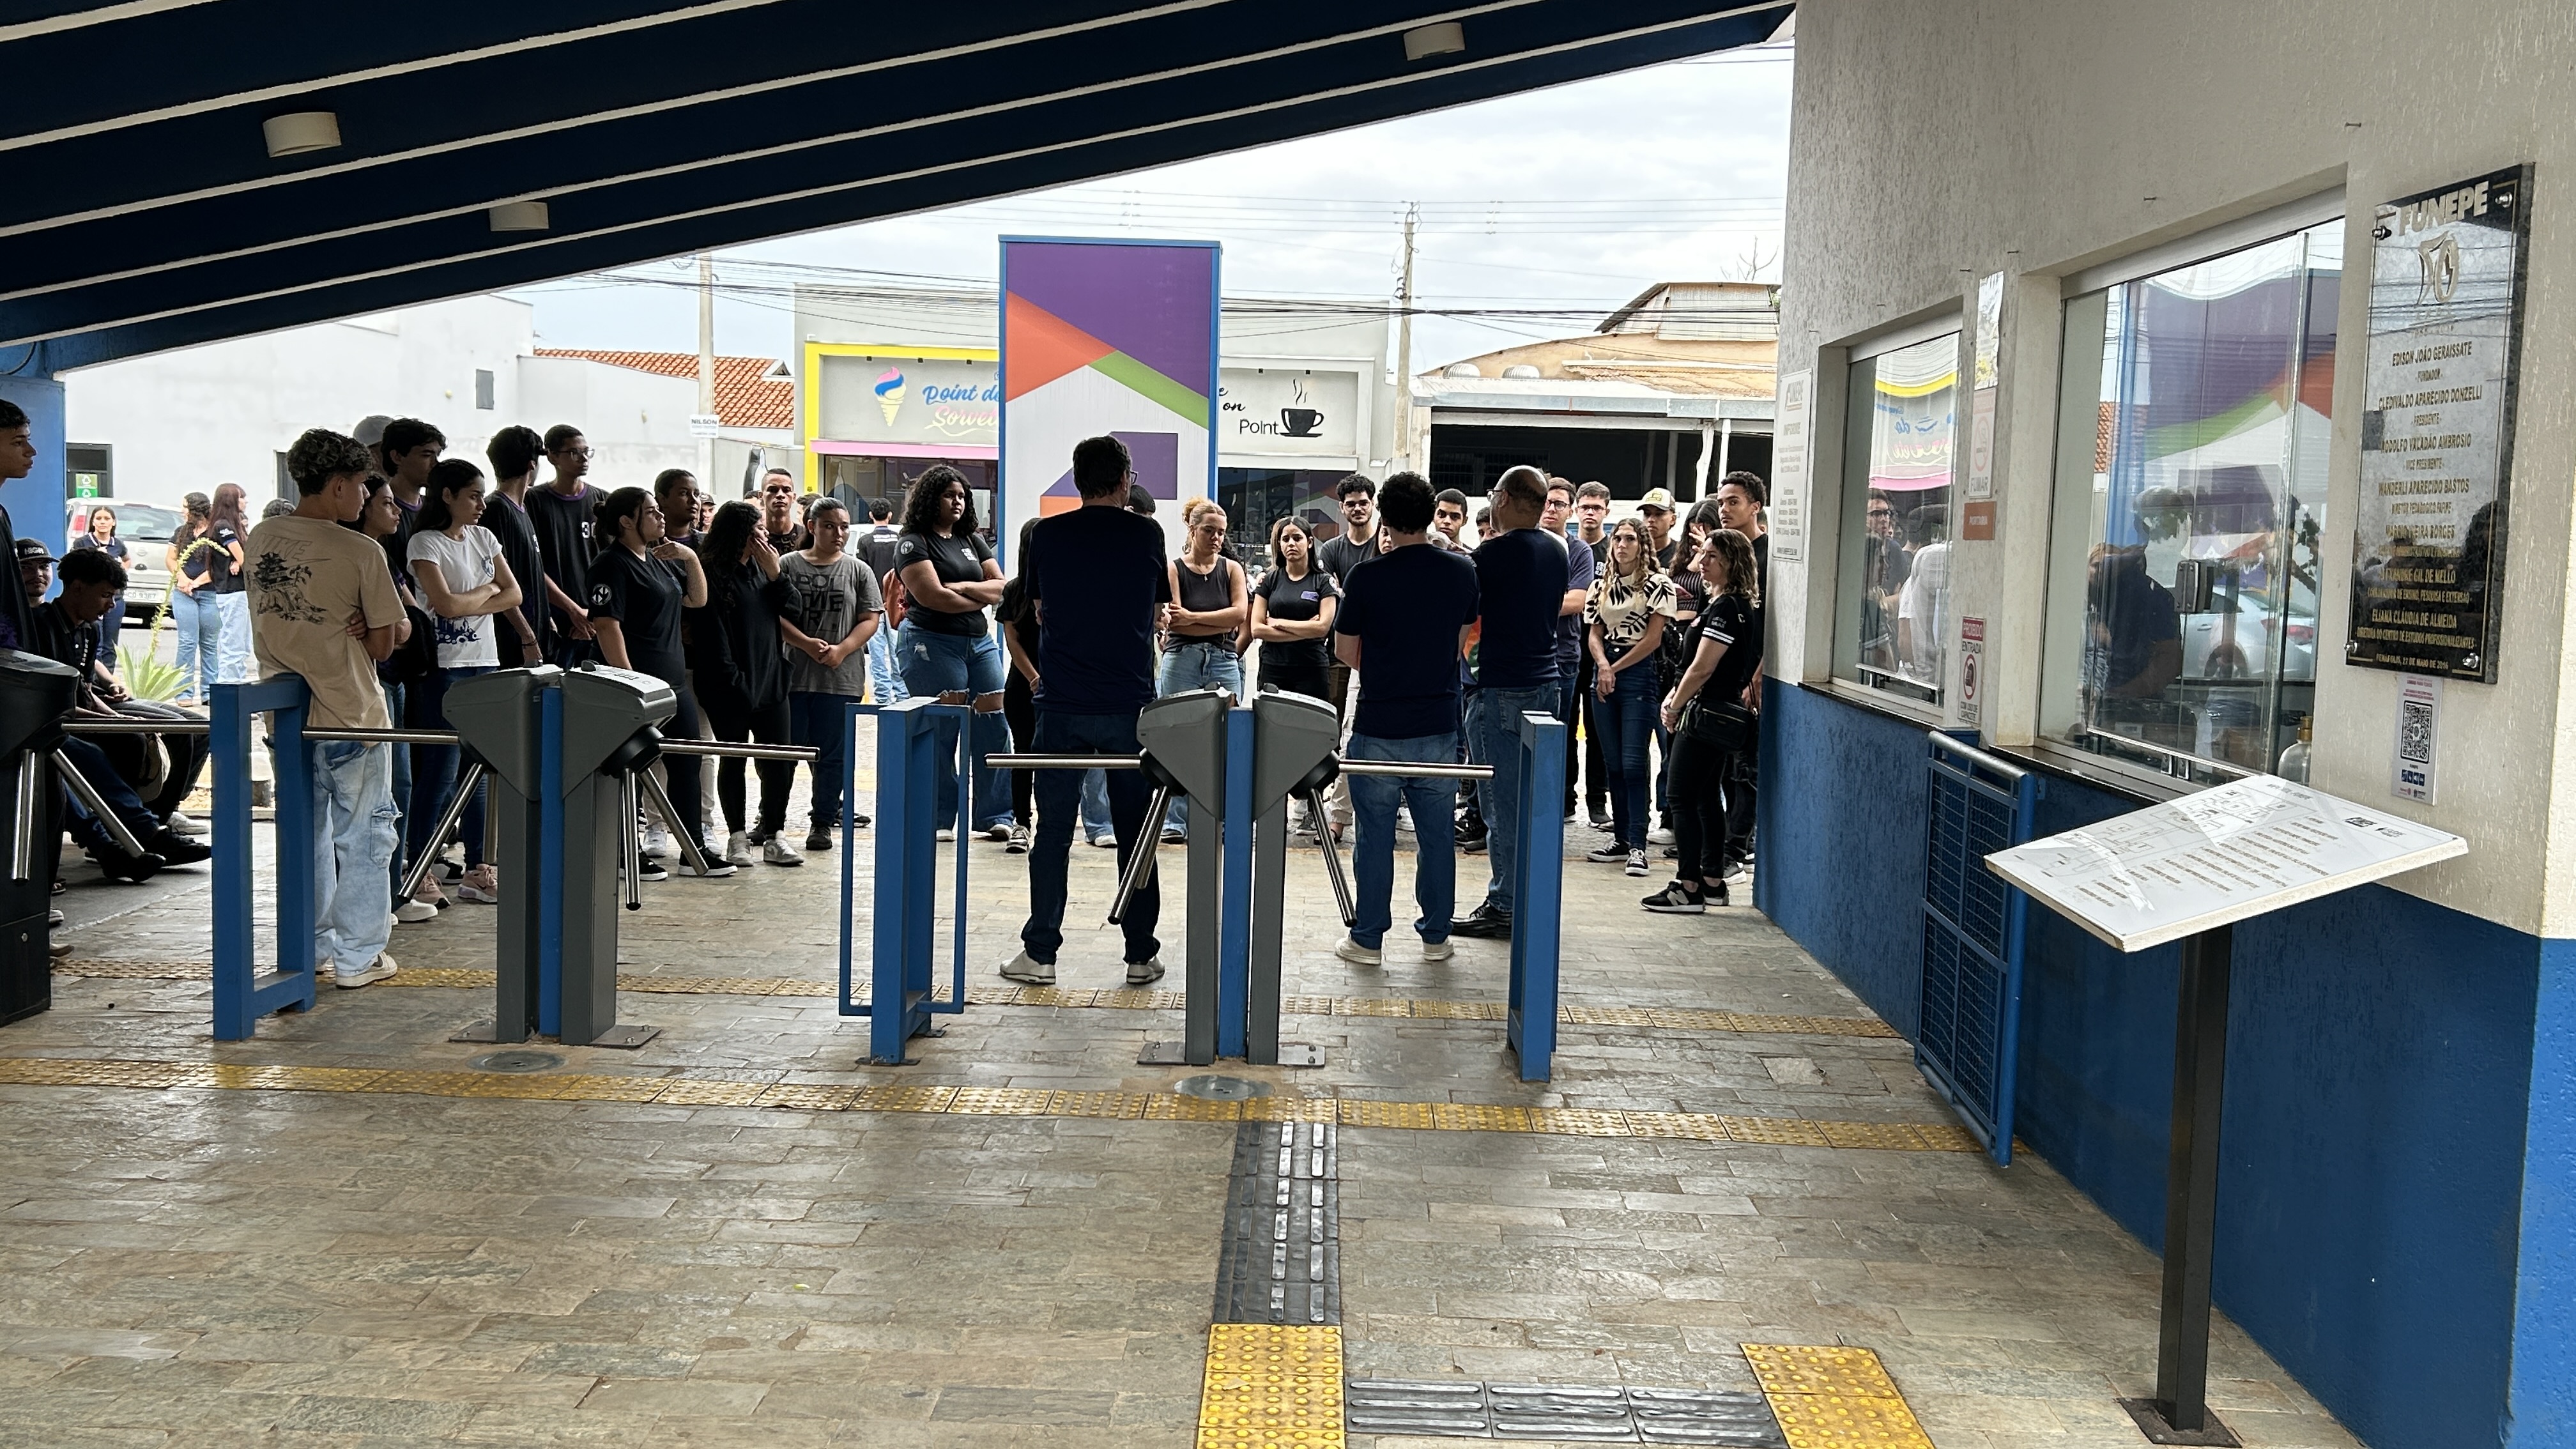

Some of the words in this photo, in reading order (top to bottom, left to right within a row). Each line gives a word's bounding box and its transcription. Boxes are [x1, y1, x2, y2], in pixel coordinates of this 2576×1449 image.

[2398, 181, 2489, 236] FUNEPE
[2392, 349, 2414, 367] EDISON
[2433, 341, 2472, 361] GERAISSATE
[922, 383, 978, 405] Point
[2414, 388, 2450, 407] APARECIDO
[2451, 385, 2483, 402] DONZELLI
[1239, 418, 1279, 435] Point
[2408, 479, 2443, 495] APARECIDO
[2444, 477, 2470, 494] BASTOS
